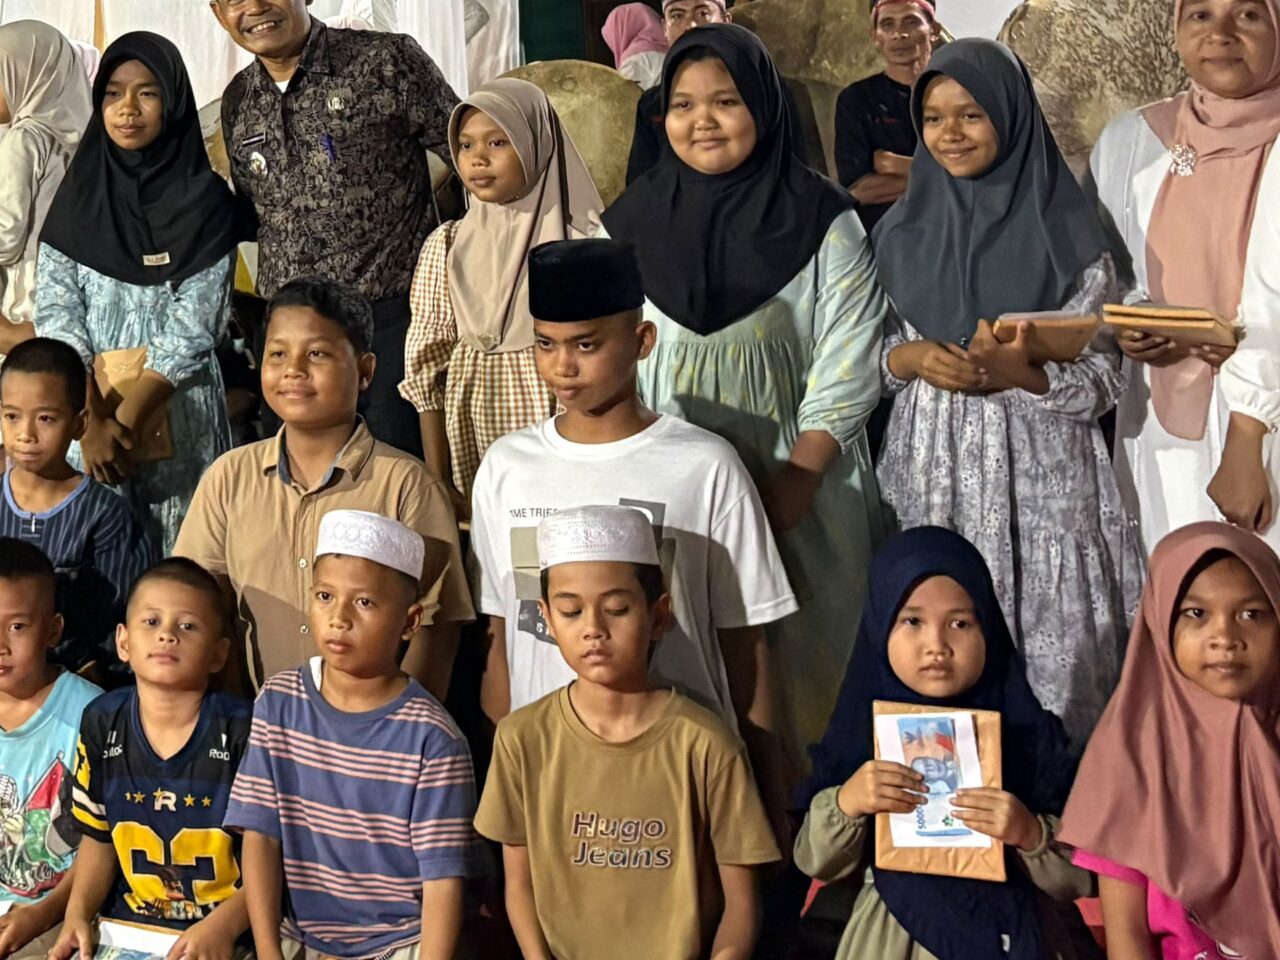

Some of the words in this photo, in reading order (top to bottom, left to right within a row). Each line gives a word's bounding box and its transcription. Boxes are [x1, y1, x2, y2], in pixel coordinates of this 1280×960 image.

[572, 811, 666, 844] Hugo
[916, 806, 926, 829] 5000
[573, 840, 672, 868] Jeans
